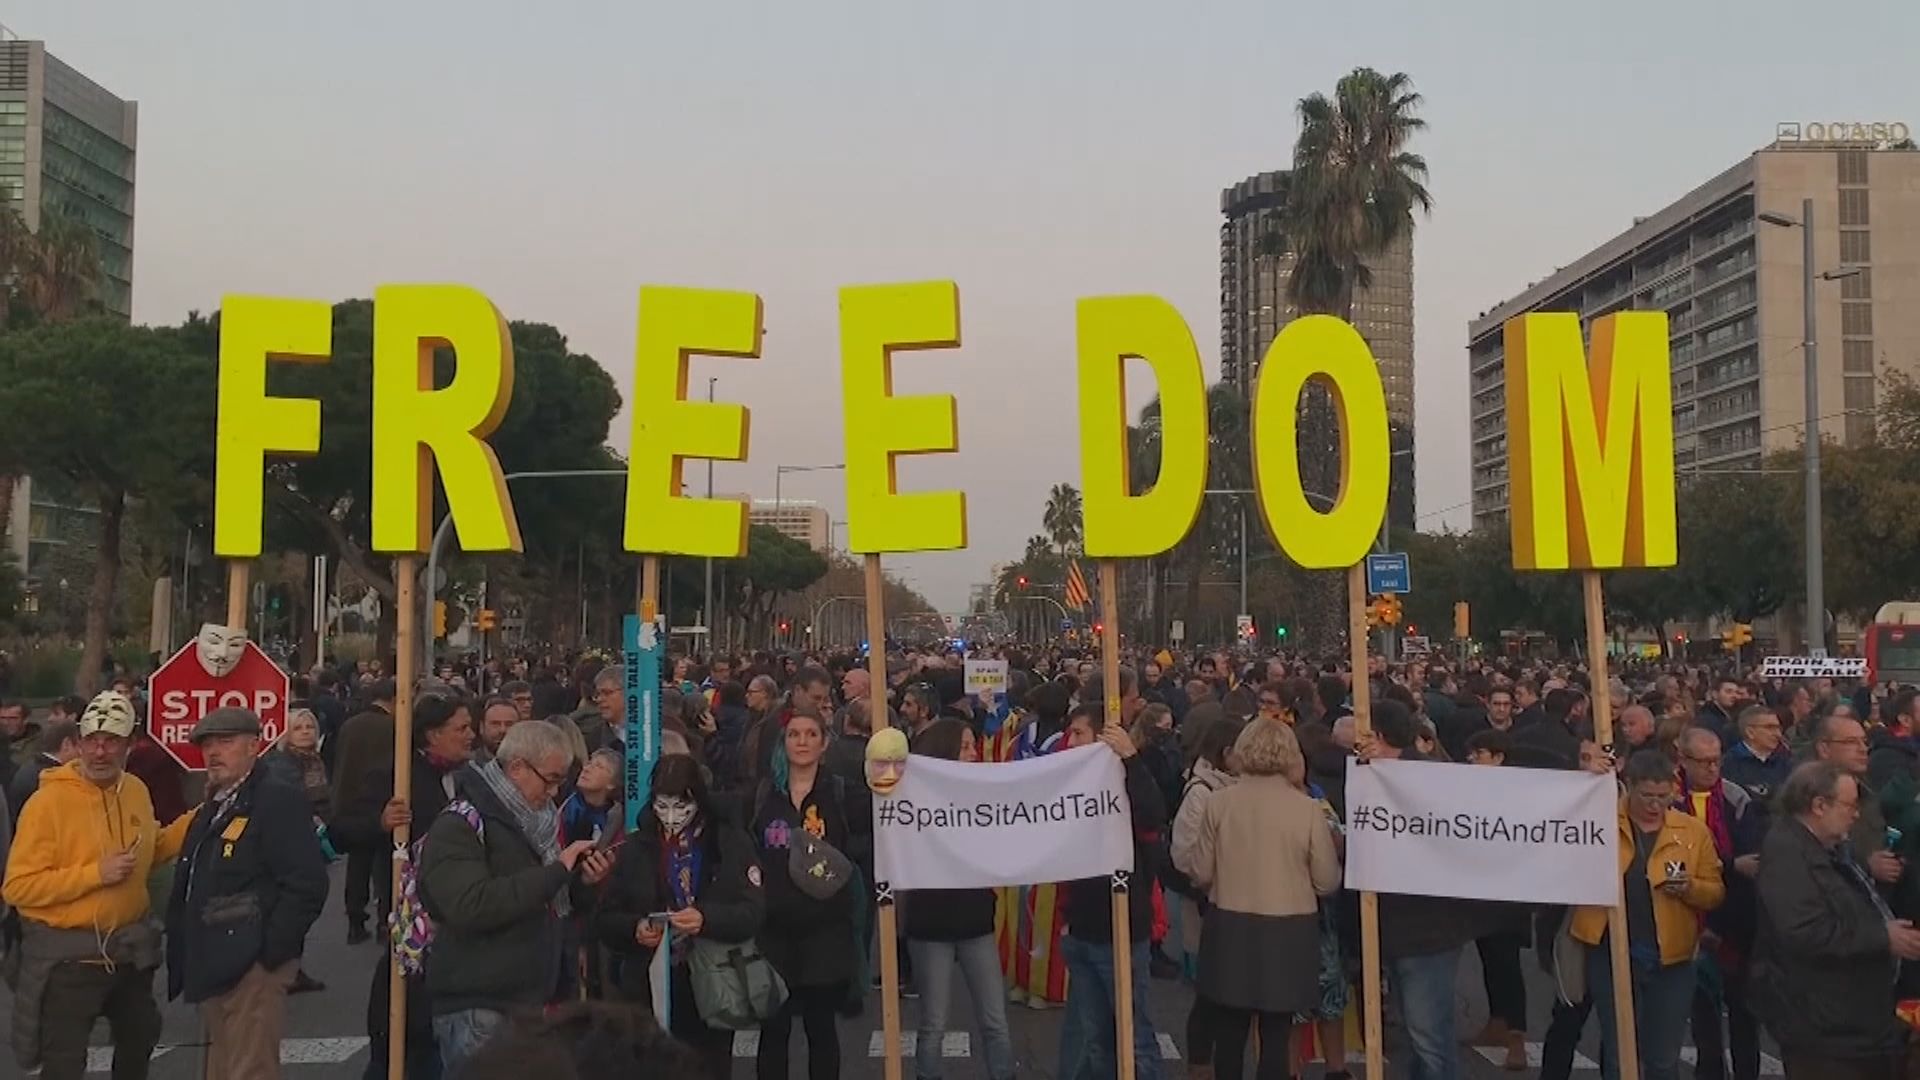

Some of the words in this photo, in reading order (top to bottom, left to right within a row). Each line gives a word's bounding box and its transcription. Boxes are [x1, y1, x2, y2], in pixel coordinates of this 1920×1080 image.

[1806, 122, 1909, 142] OCASO
[214, 281, 1677, 571] FREEDOM
[628, 652, 639, 689] TALK!
[1764, 667, 1806, 676] AND
[1833, 658, 1864, 667] SIT
[161, 690, 278, 720] STOP
[628, 694, 639, 725] AND
[628, 730, 639, 750] SIT
[628, 756, 639, 801] SPAIN,
[879, 790, 1121, 832] #SpainSitAndTalk
[1353, 806, 1606, 846] #SpainSitAndTalk
